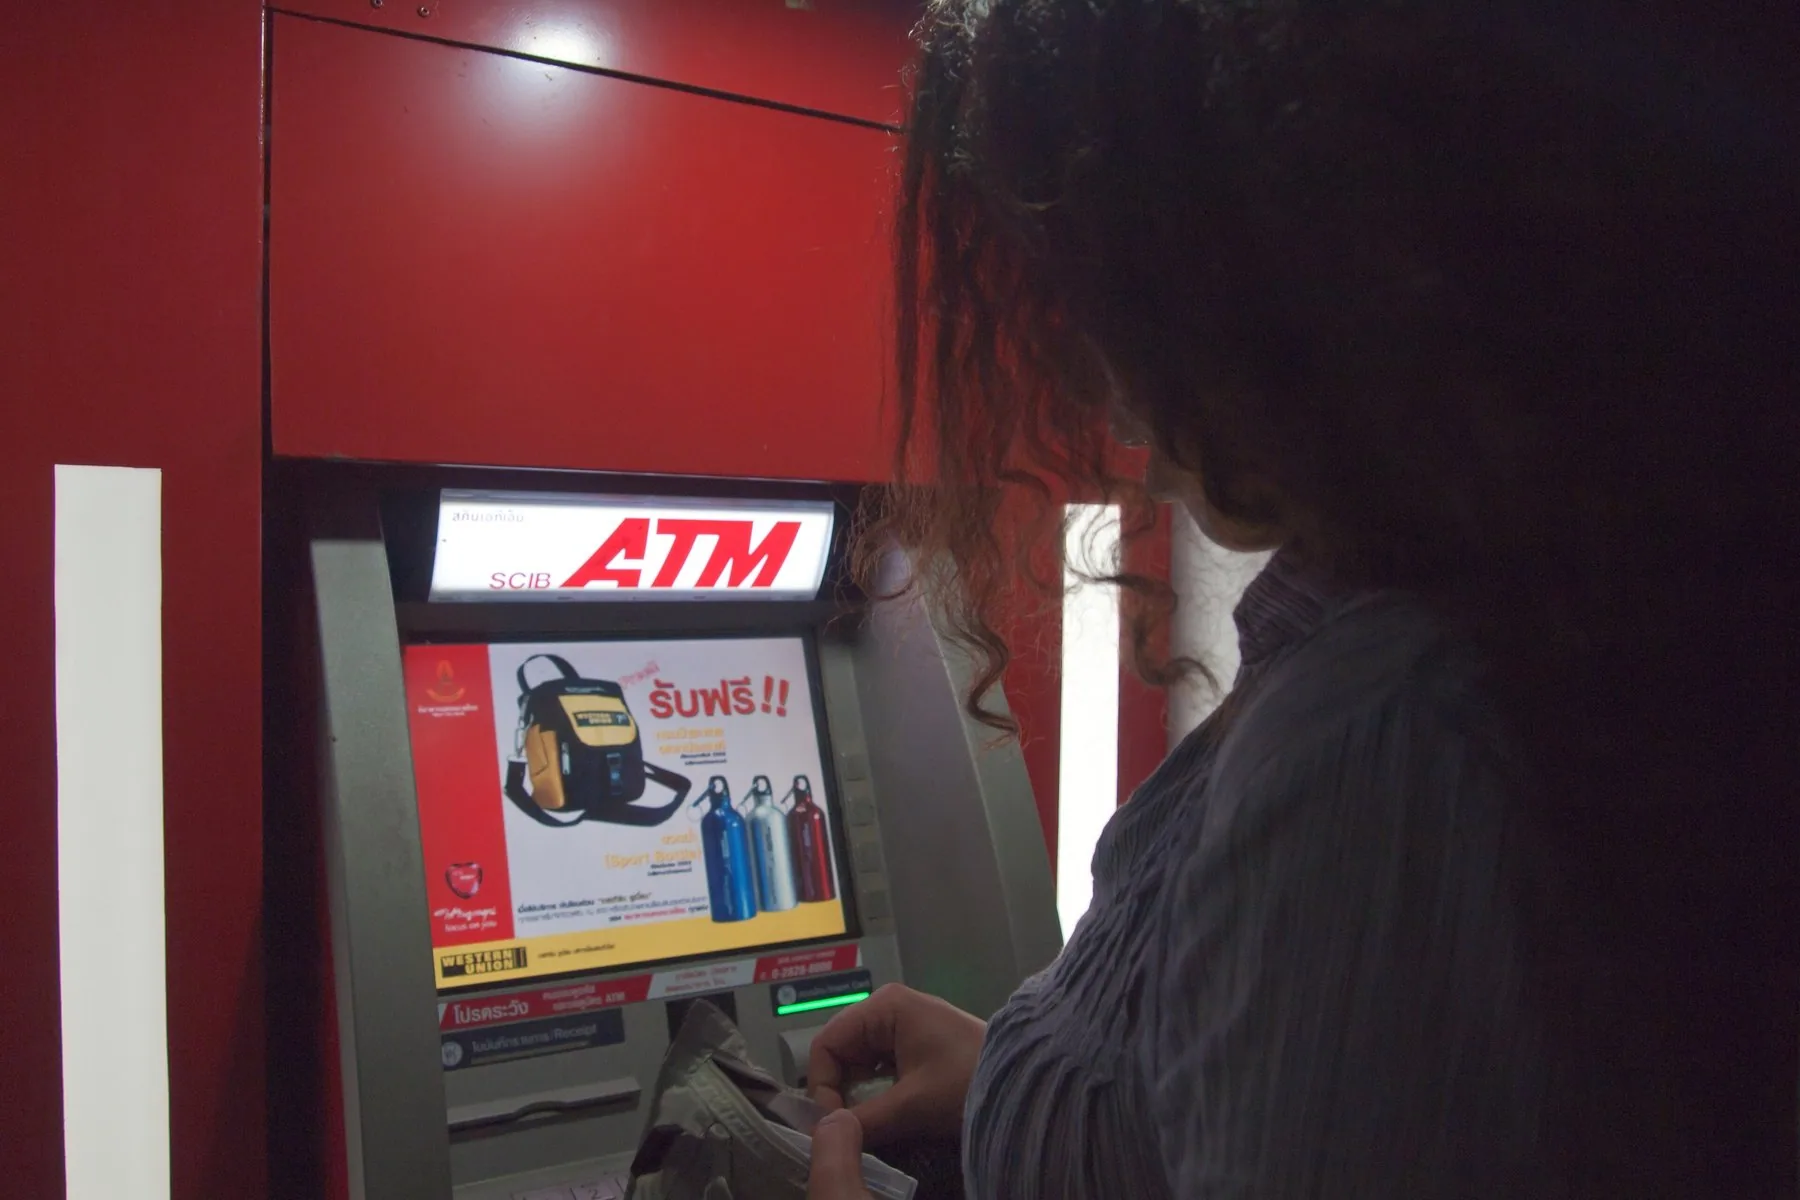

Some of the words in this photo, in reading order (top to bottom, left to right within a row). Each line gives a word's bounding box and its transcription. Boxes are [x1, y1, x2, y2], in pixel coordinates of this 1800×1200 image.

[489, 572, 551, 589] SCIB
[559, 517, 802, 588] ATM
[442, 948, 513, 967] WESTERN
[465, 959, 513, 975] UNION
